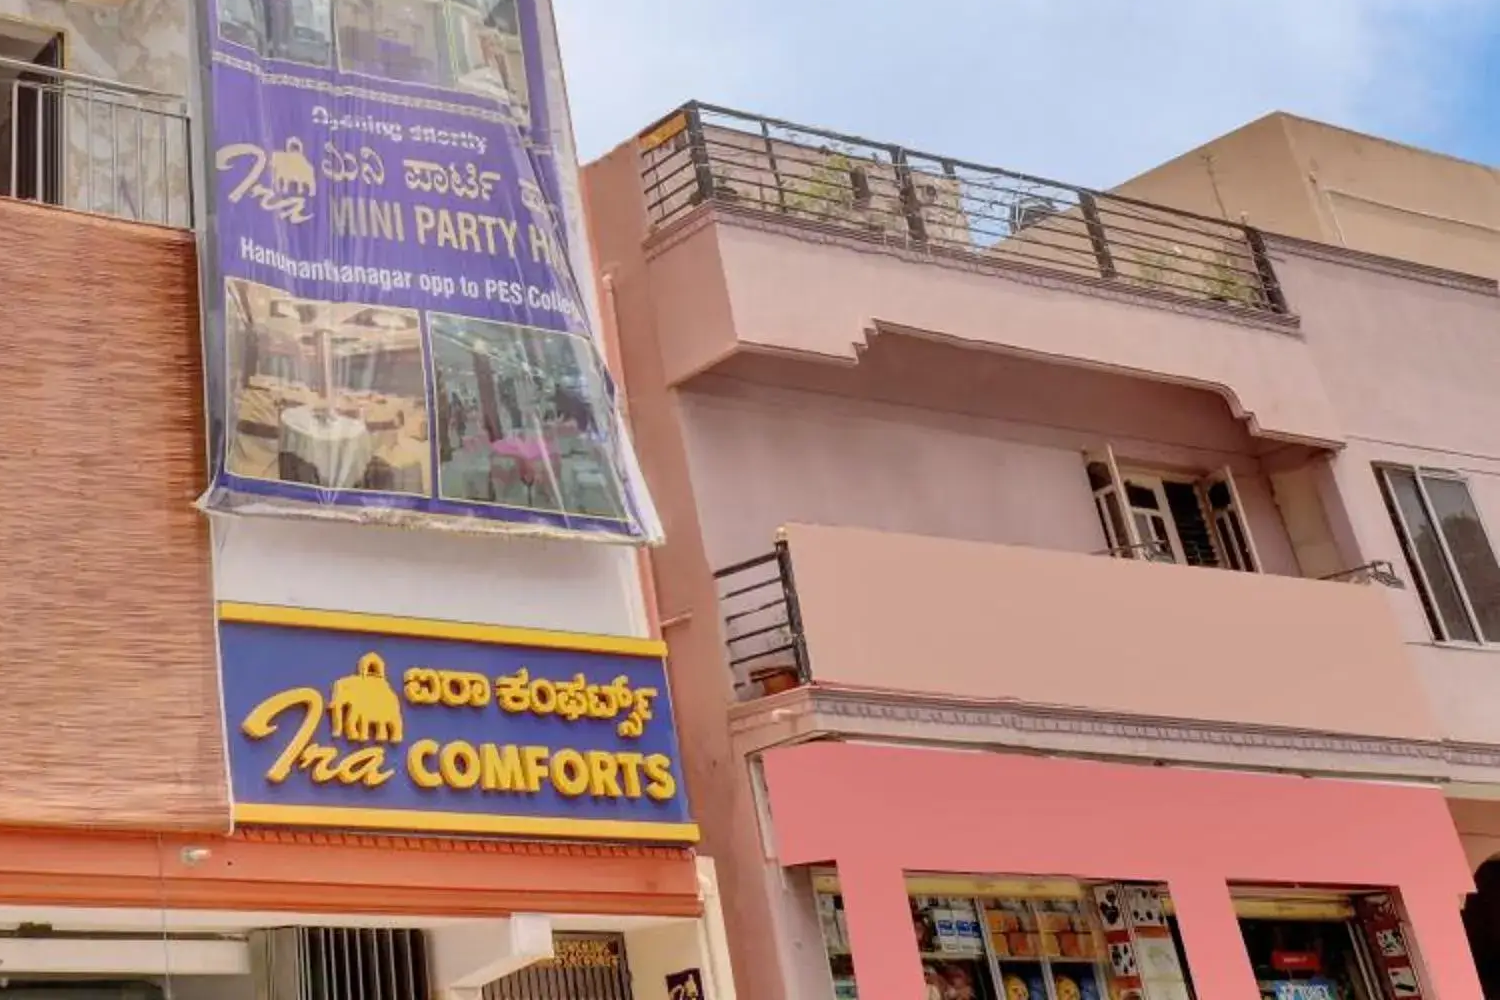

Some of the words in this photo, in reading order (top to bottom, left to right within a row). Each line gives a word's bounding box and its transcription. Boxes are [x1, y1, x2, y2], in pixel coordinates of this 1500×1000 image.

[215, 142, 315, 225] Ira
[331, 198, 405, 242] MINI
[414, 204, 518, 259] PARTY
[419, 273, 455, 297] opp
[460, 275, 479, 299] to
[484, 278, 523, 306] PES
[242, 687, 396, 788] Ira
[407, 739, 677, 801] COMFORTS
